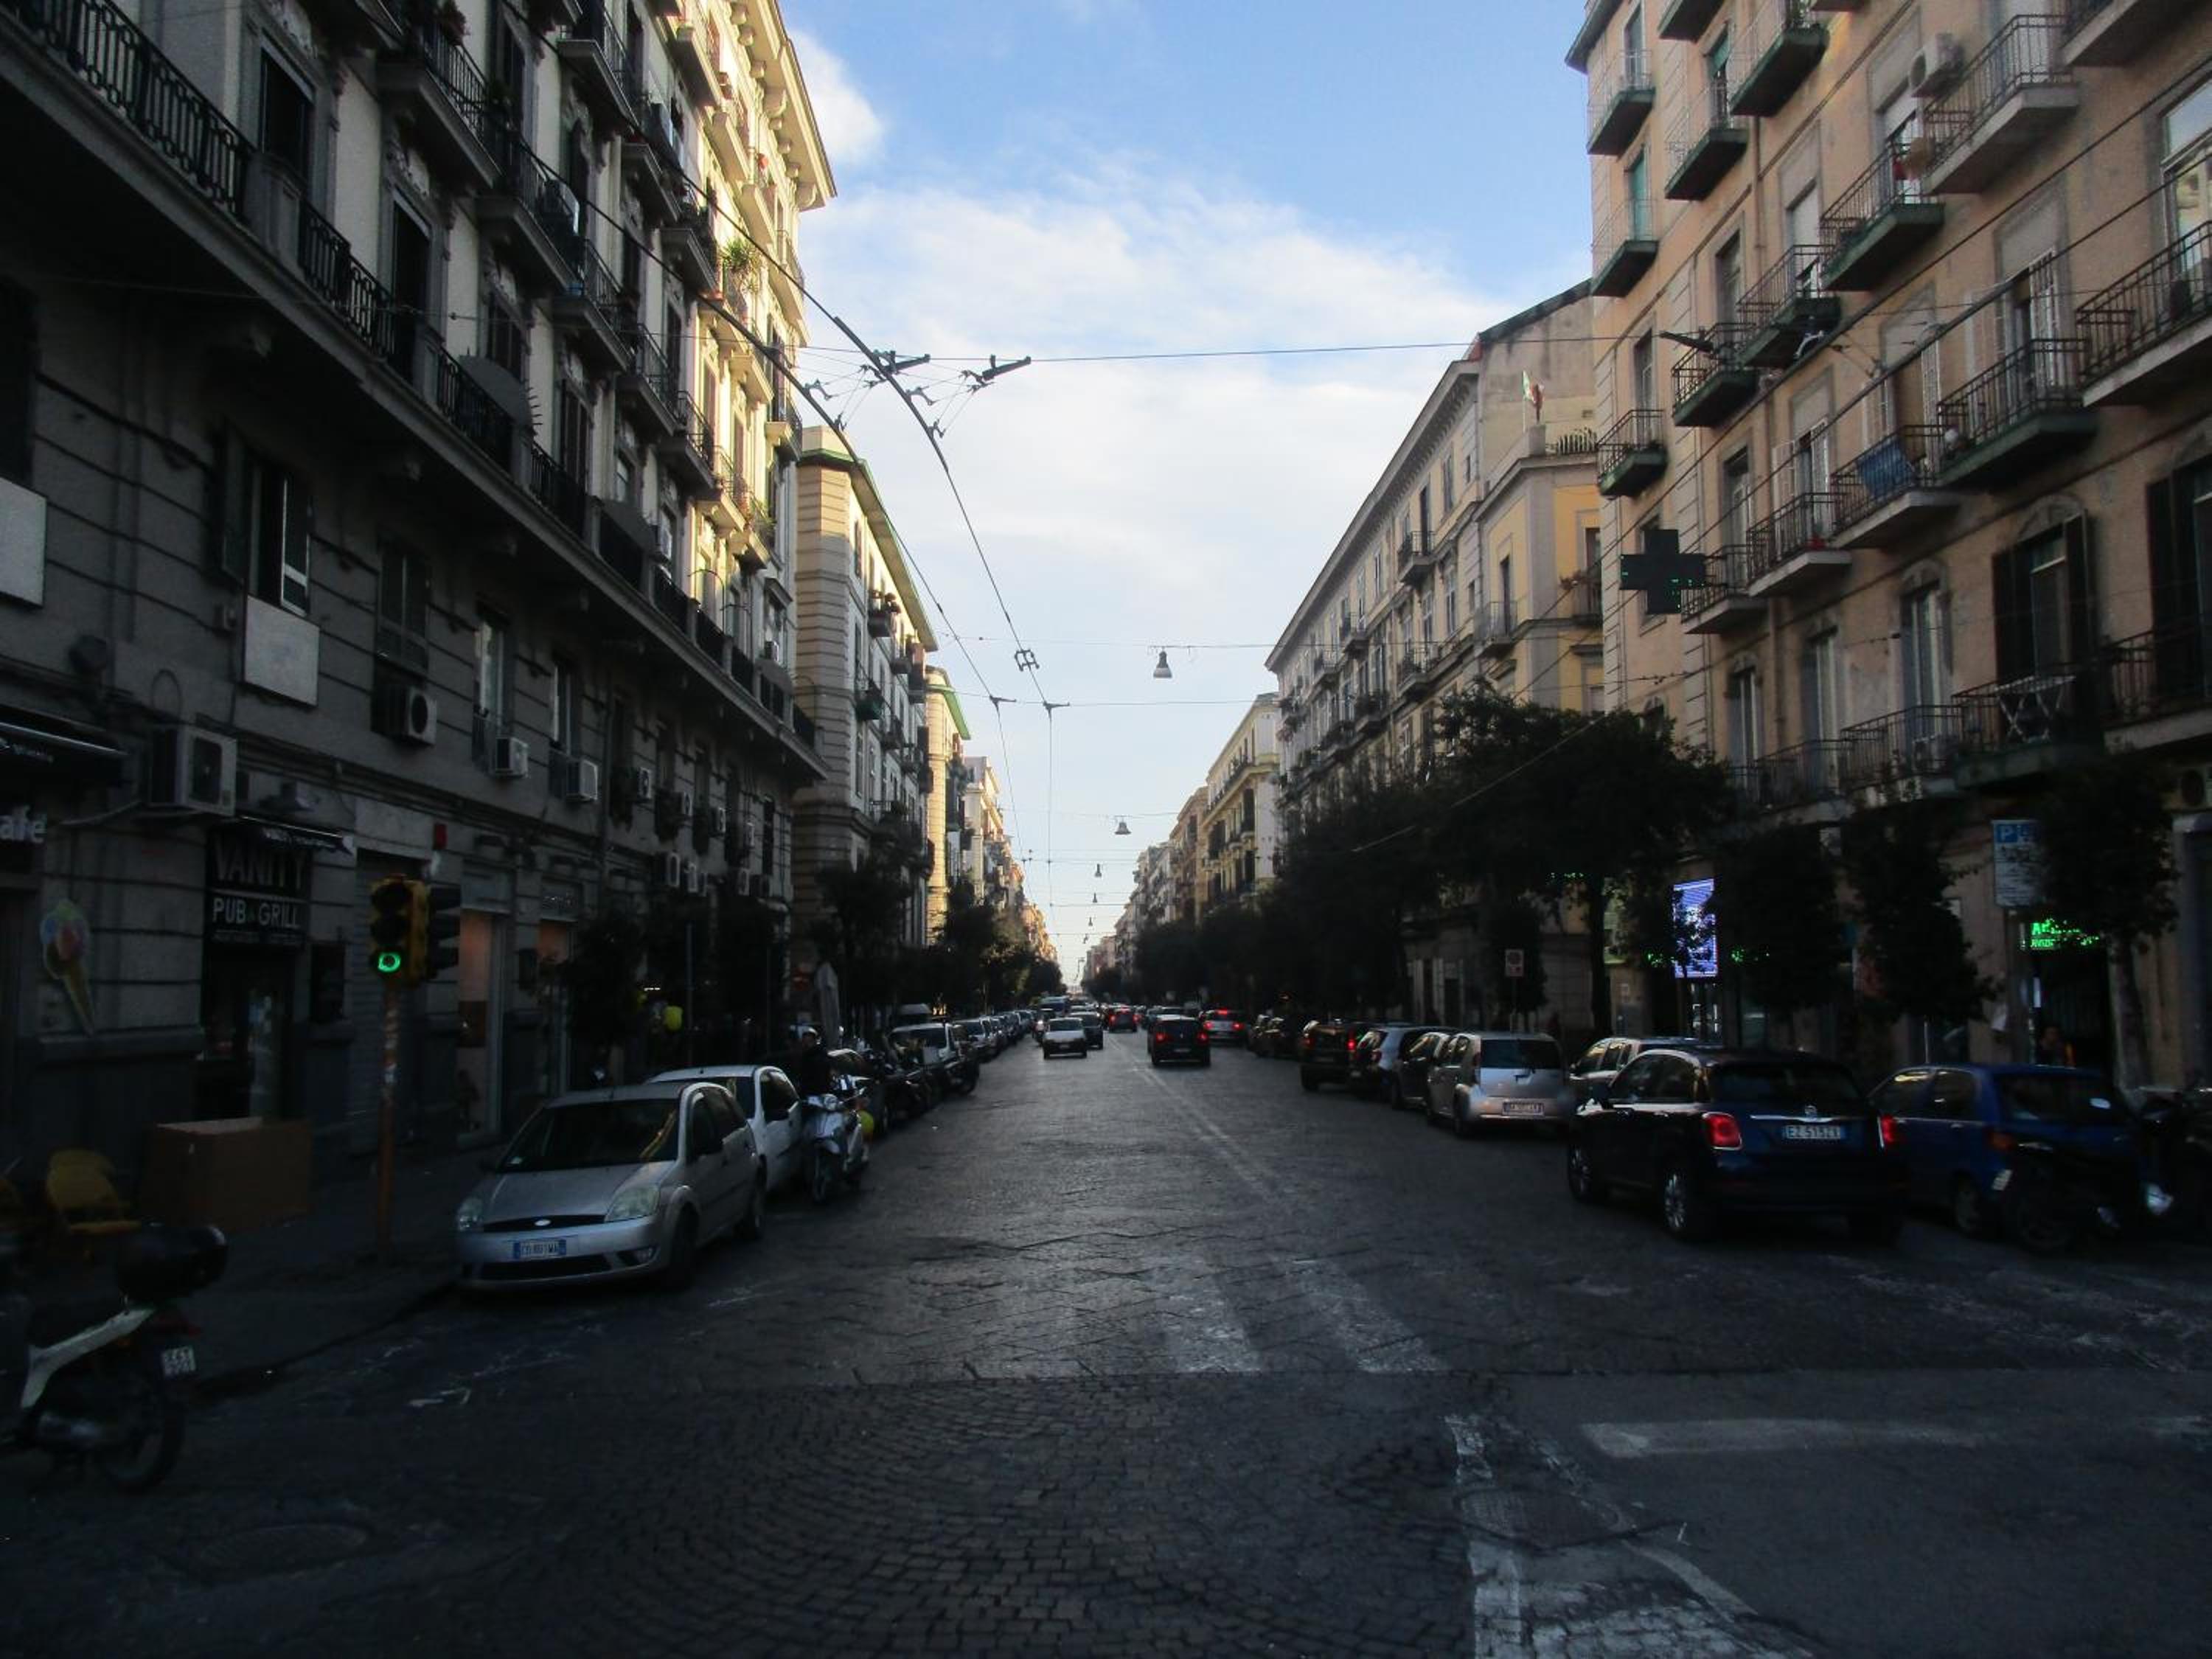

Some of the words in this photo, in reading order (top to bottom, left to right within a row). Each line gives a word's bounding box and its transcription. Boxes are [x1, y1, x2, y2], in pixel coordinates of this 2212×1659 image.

[212, 841, 307, 890] VANITY
[212, 897, 248, 924] PUB
[259, 901, 301, 929] GRILL
